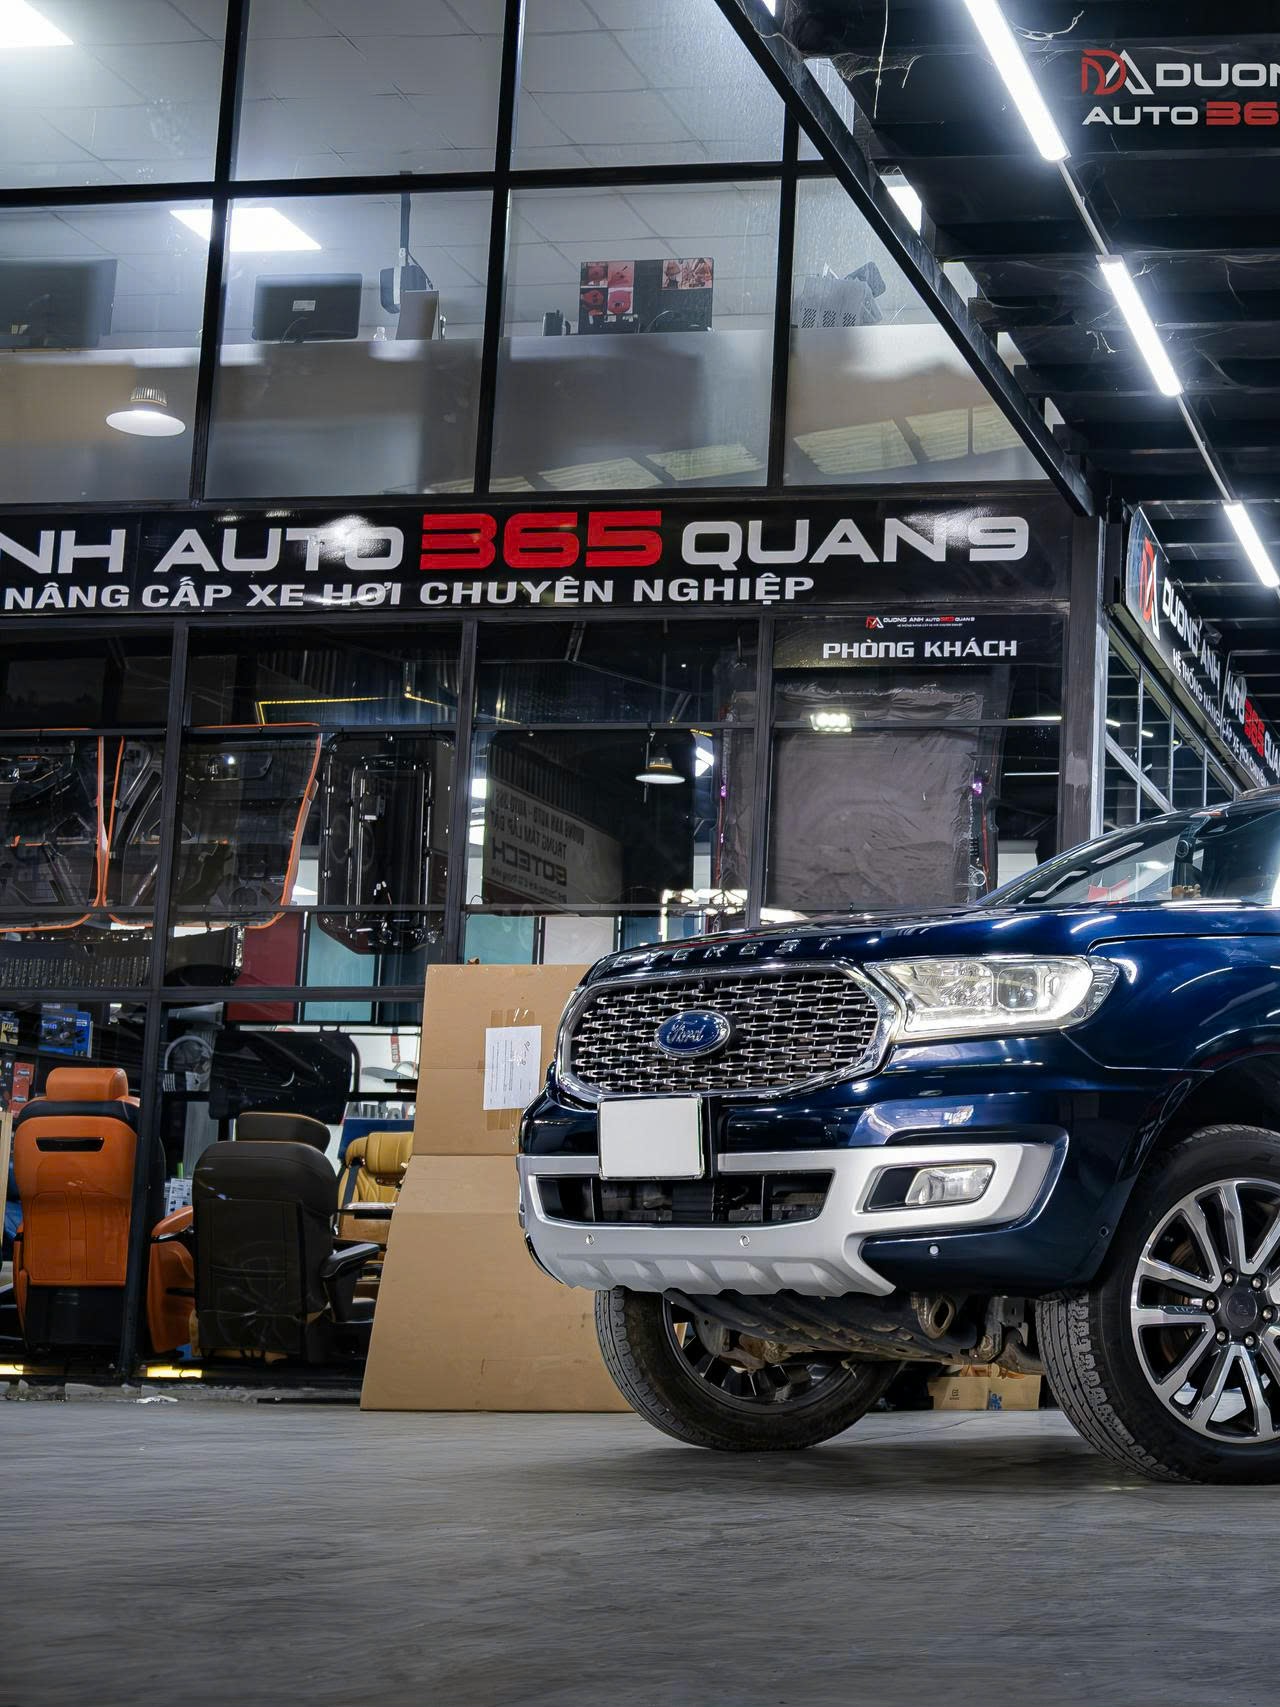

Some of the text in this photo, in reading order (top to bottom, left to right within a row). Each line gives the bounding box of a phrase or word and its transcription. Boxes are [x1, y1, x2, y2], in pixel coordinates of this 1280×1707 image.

[1081, 106, 1199, 125] AUTO
[153, 526, 404, 573] AUTO
[419, 510, 662, 570] 365
[681, 517, 947, 571] QUAN
[968, 516, 1030, 562] 9
[4, 573, 814, 610] NÂNG CẤP XE HƠI CHUYÊN NGHIỆP
[823, 637, 1018, 658] PHÒNG KHÁCH
[1200, 639, 1220, 690] ANH
[613, 935, 841, 968] EVEREST
[666, 1019, 706, 1044] Ford
